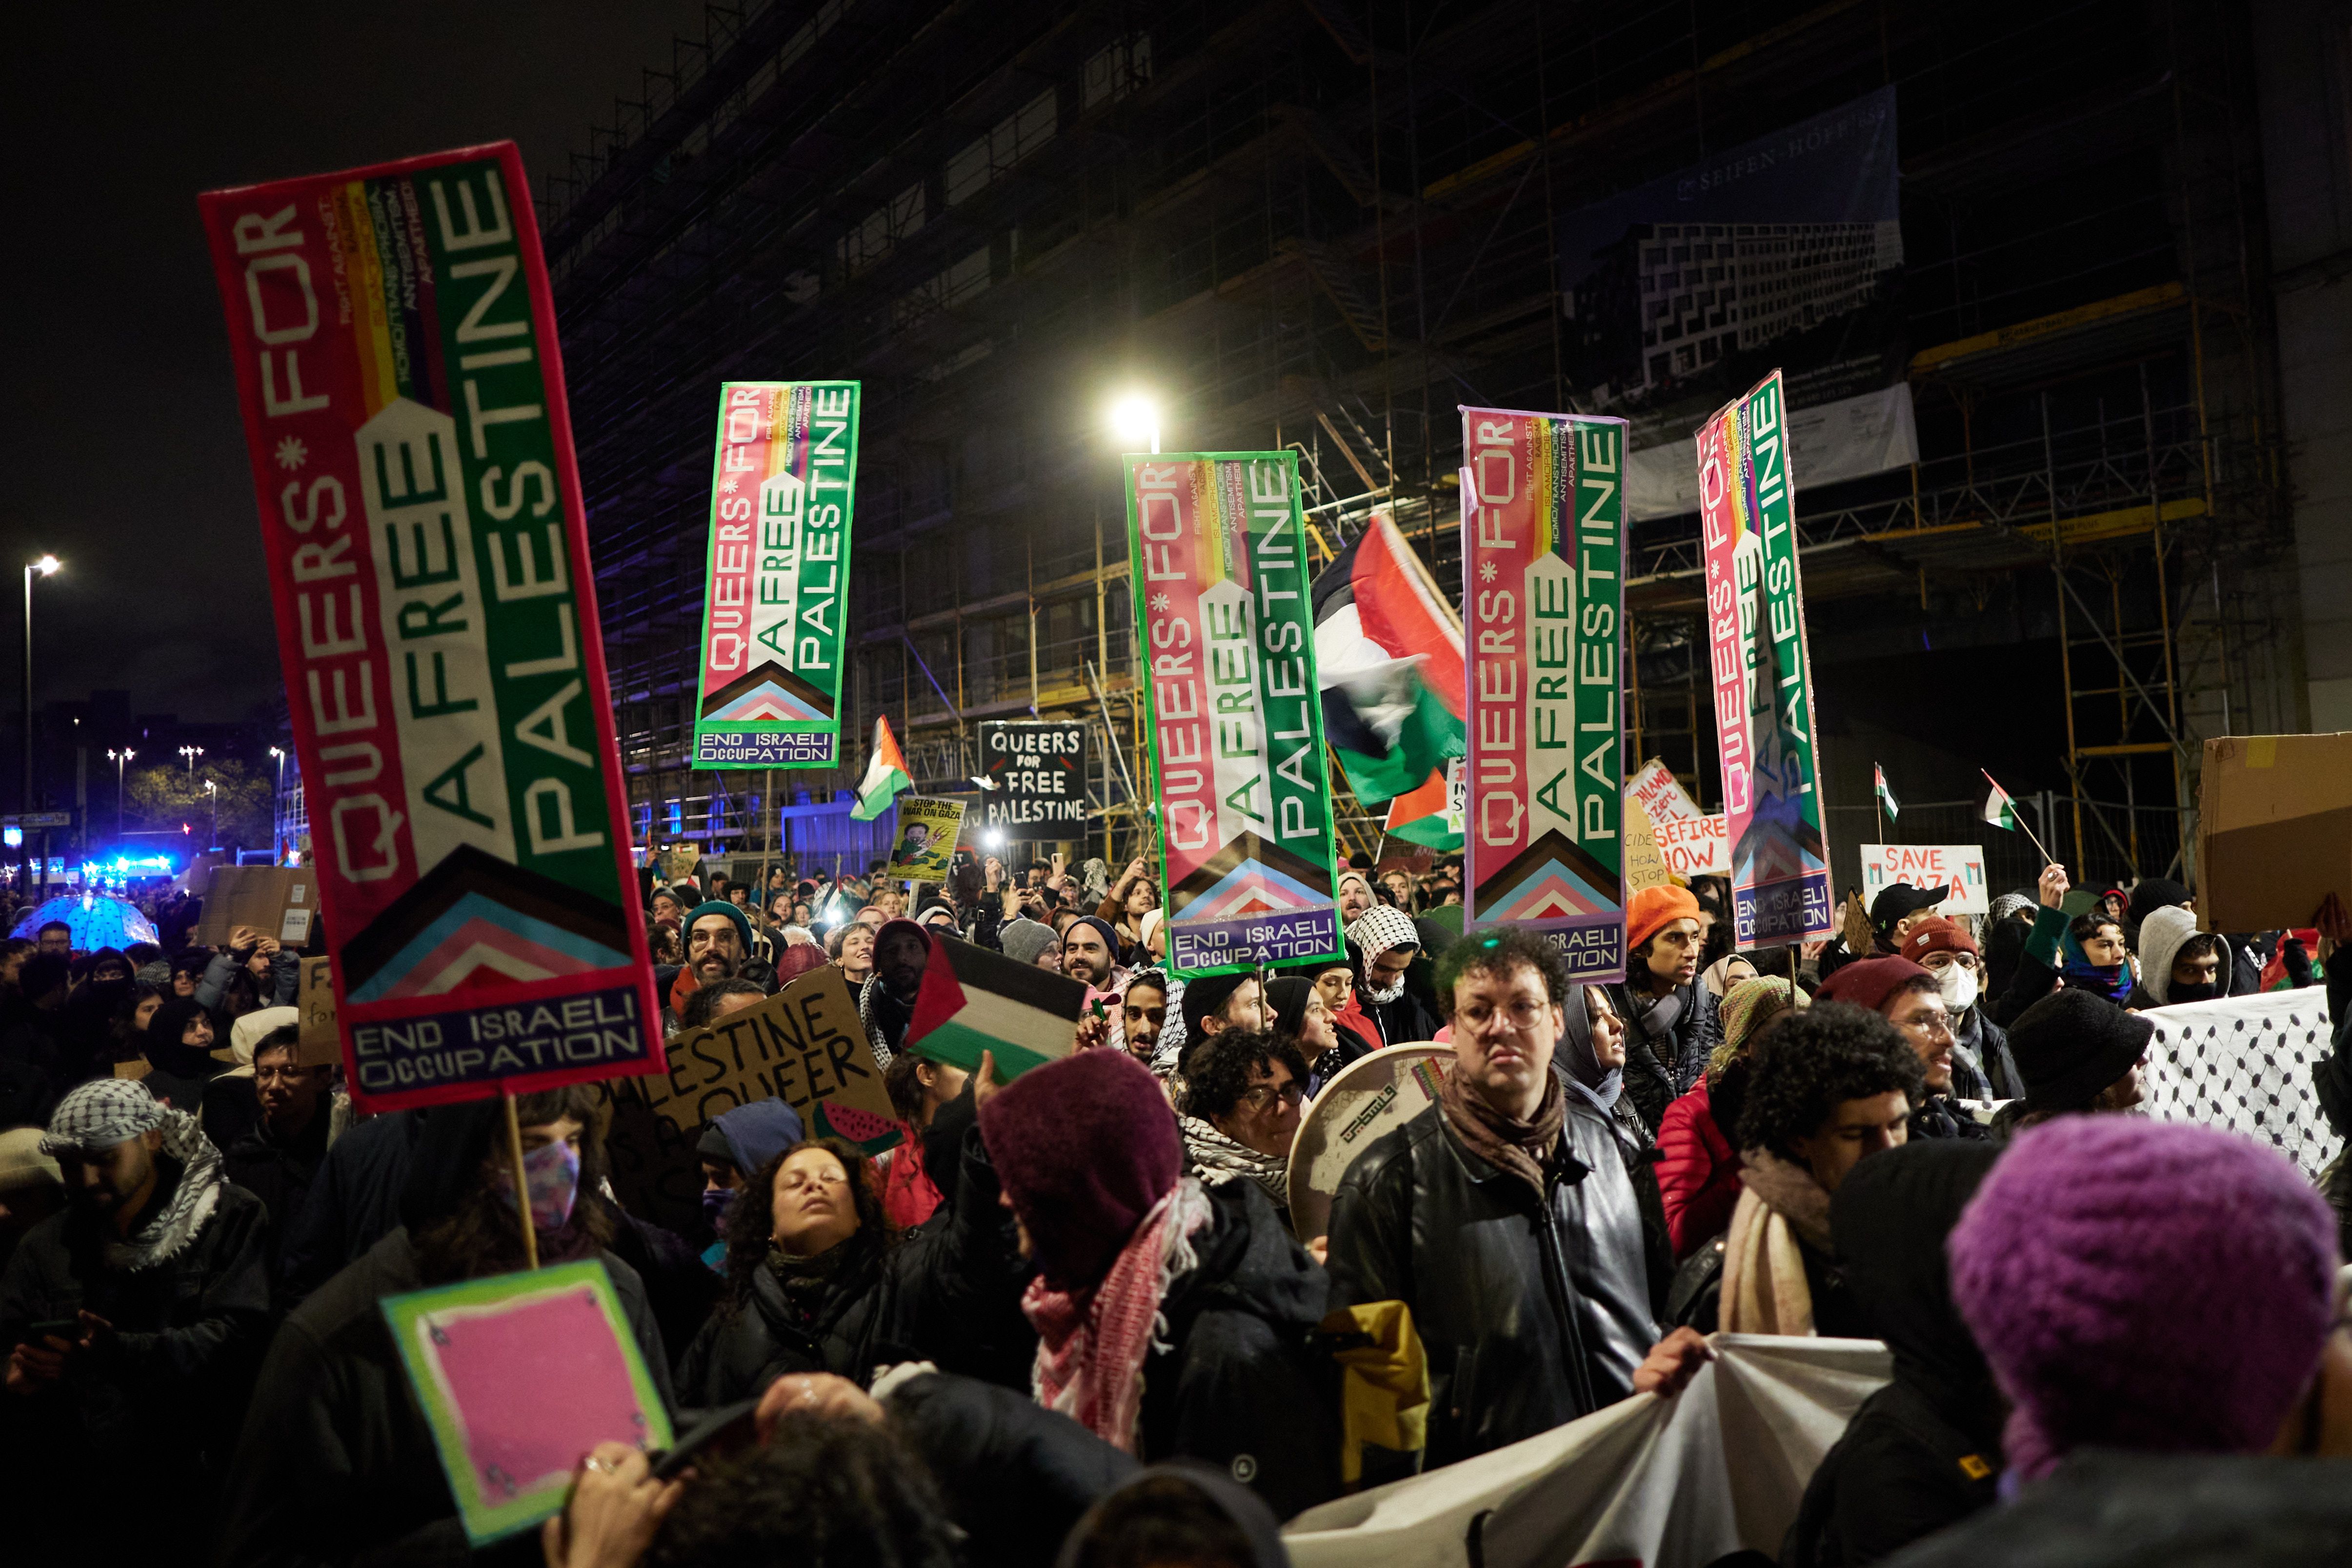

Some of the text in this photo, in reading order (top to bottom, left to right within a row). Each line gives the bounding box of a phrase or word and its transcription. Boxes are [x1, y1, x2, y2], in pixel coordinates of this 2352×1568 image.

[232, 202, 330, 418] FOR
[725, 388, 761, 472] FOR
[429, 168, 605, 855] PALESTINE
[1224, 462, 1238, 533] ANTISEMITISM,
[1233, 462, 1246, 519] APARTHEID!
[1477, 421, 1516, 549] FOR
[1703, 430, 1728, 551] FOR
[799, 388, 850, 669] PALESTINE
[1139, 465, 1187, 582] FOR
[1194, 508, 1202, 535] FIGHT
[757, 488, 798, 656] A FREE
[1753, 387, 1812, 795] PALESTINE
[374, 432, 495, 831] A FREE
[1248, 464, 1319, 839] PALESTINE
[1580, 429, 1616, 840] PALESTINE
[1738, 547, 1778, 782] A FREE
[1207, 601, 1265, 824] A FREE
[1534, 576, 1571, 823] A FREE
[700, 733, 828, 746] END ISRAELI
[700, 747, 827, 762] OCCUPATION
[990, 730, 1080, 754] QUEERS
[1016, 754, 1042, 769] FOR
[914, 799, 954, 810] STOP THE
[1005, 770, 1066, 794] FREE
[1647, 789, 1678, 818] ziert
[903, 806, 960, 820] WAR ON GAZA
[988, 799, 1086, 827] PALESTINE
[1630, 853, 1659, 867] HOW
[1631, 868, 1664, 886] STOP
[1886, 847, 1946, 871] SAVE
[1737, 885, 1826, 918] END ISRAELI
[1739, 906, 1827, 937] OCCUPATION
[1175, 918, 1332, 952] END ISRAELI
[1177, 937, 1333, 970] OCCUPATION
[353, 992, 636, 1057] END ISRAELI
[359, 1025, 642, 1089] OCCUPATION
